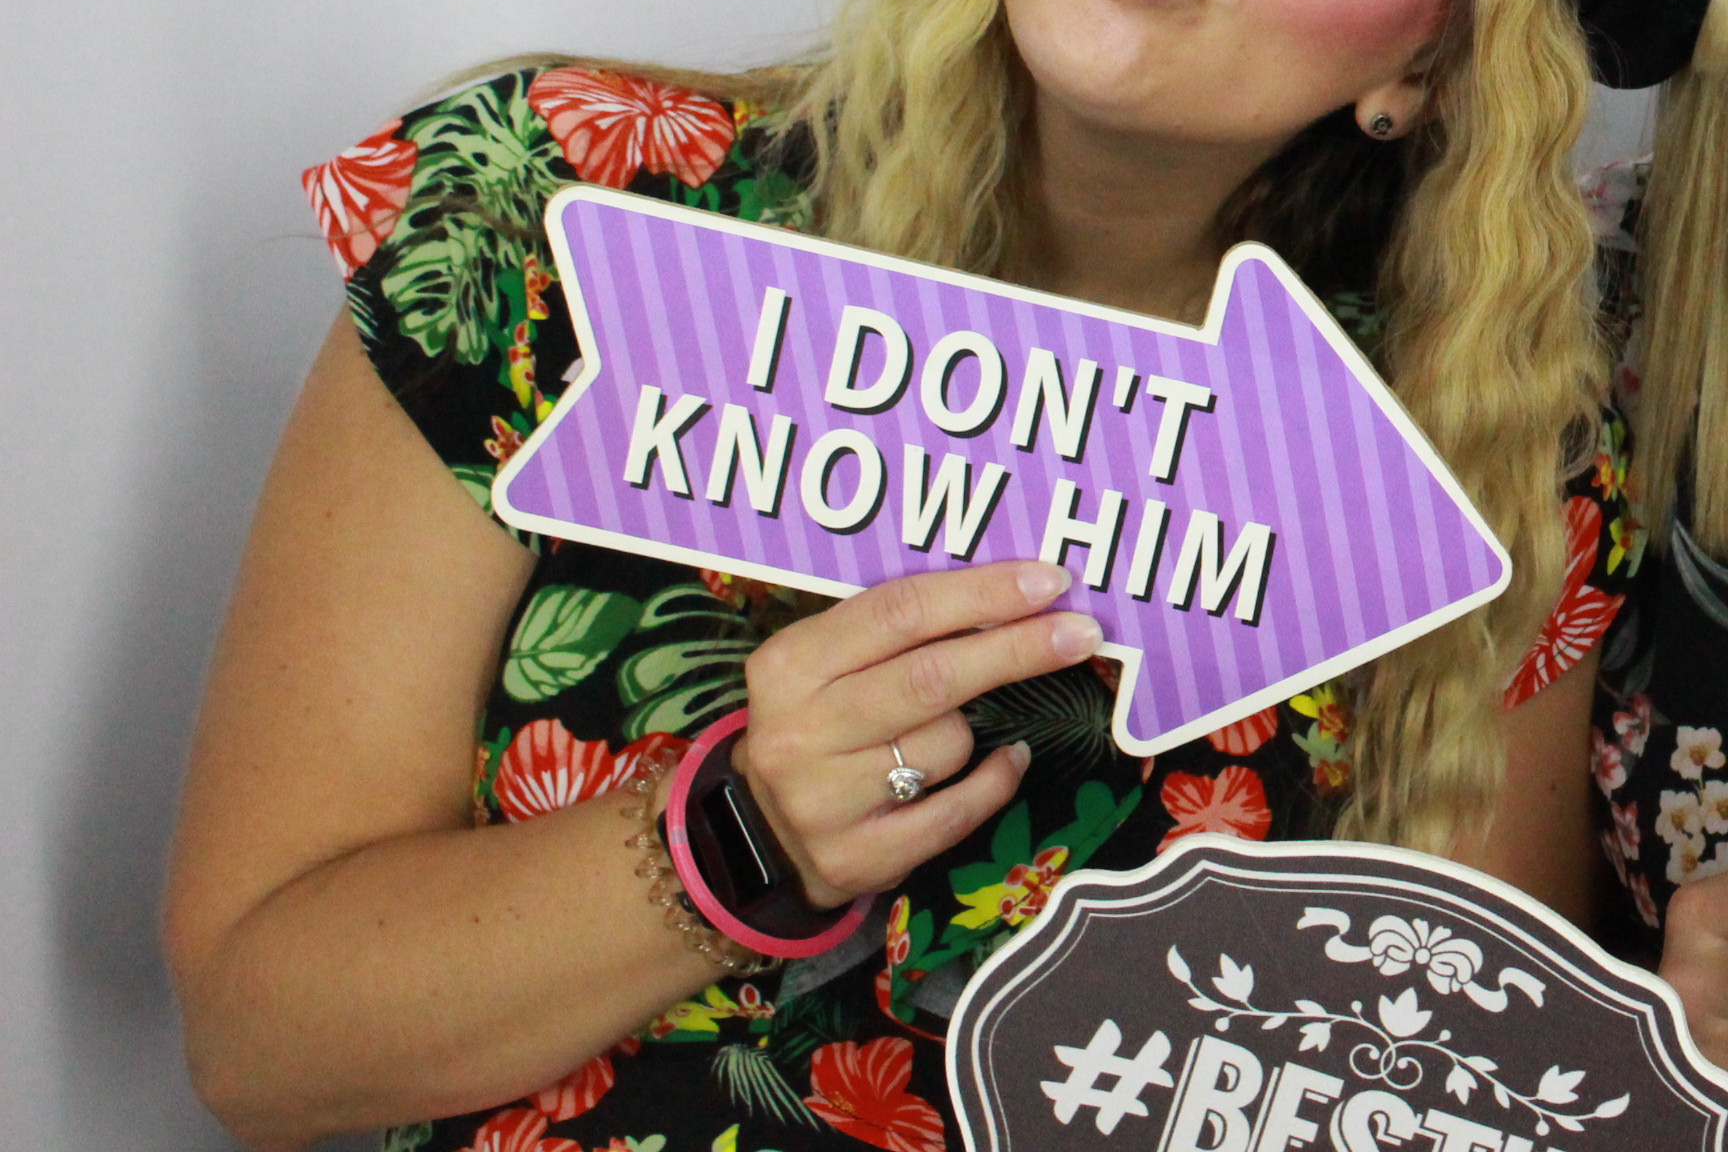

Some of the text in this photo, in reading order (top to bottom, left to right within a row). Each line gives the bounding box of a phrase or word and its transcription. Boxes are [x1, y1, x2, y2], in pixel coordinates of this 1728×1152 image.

[746, 287, 1216, 483] I DON'T
[622, 384, 1277, 627] KNOW HIM
